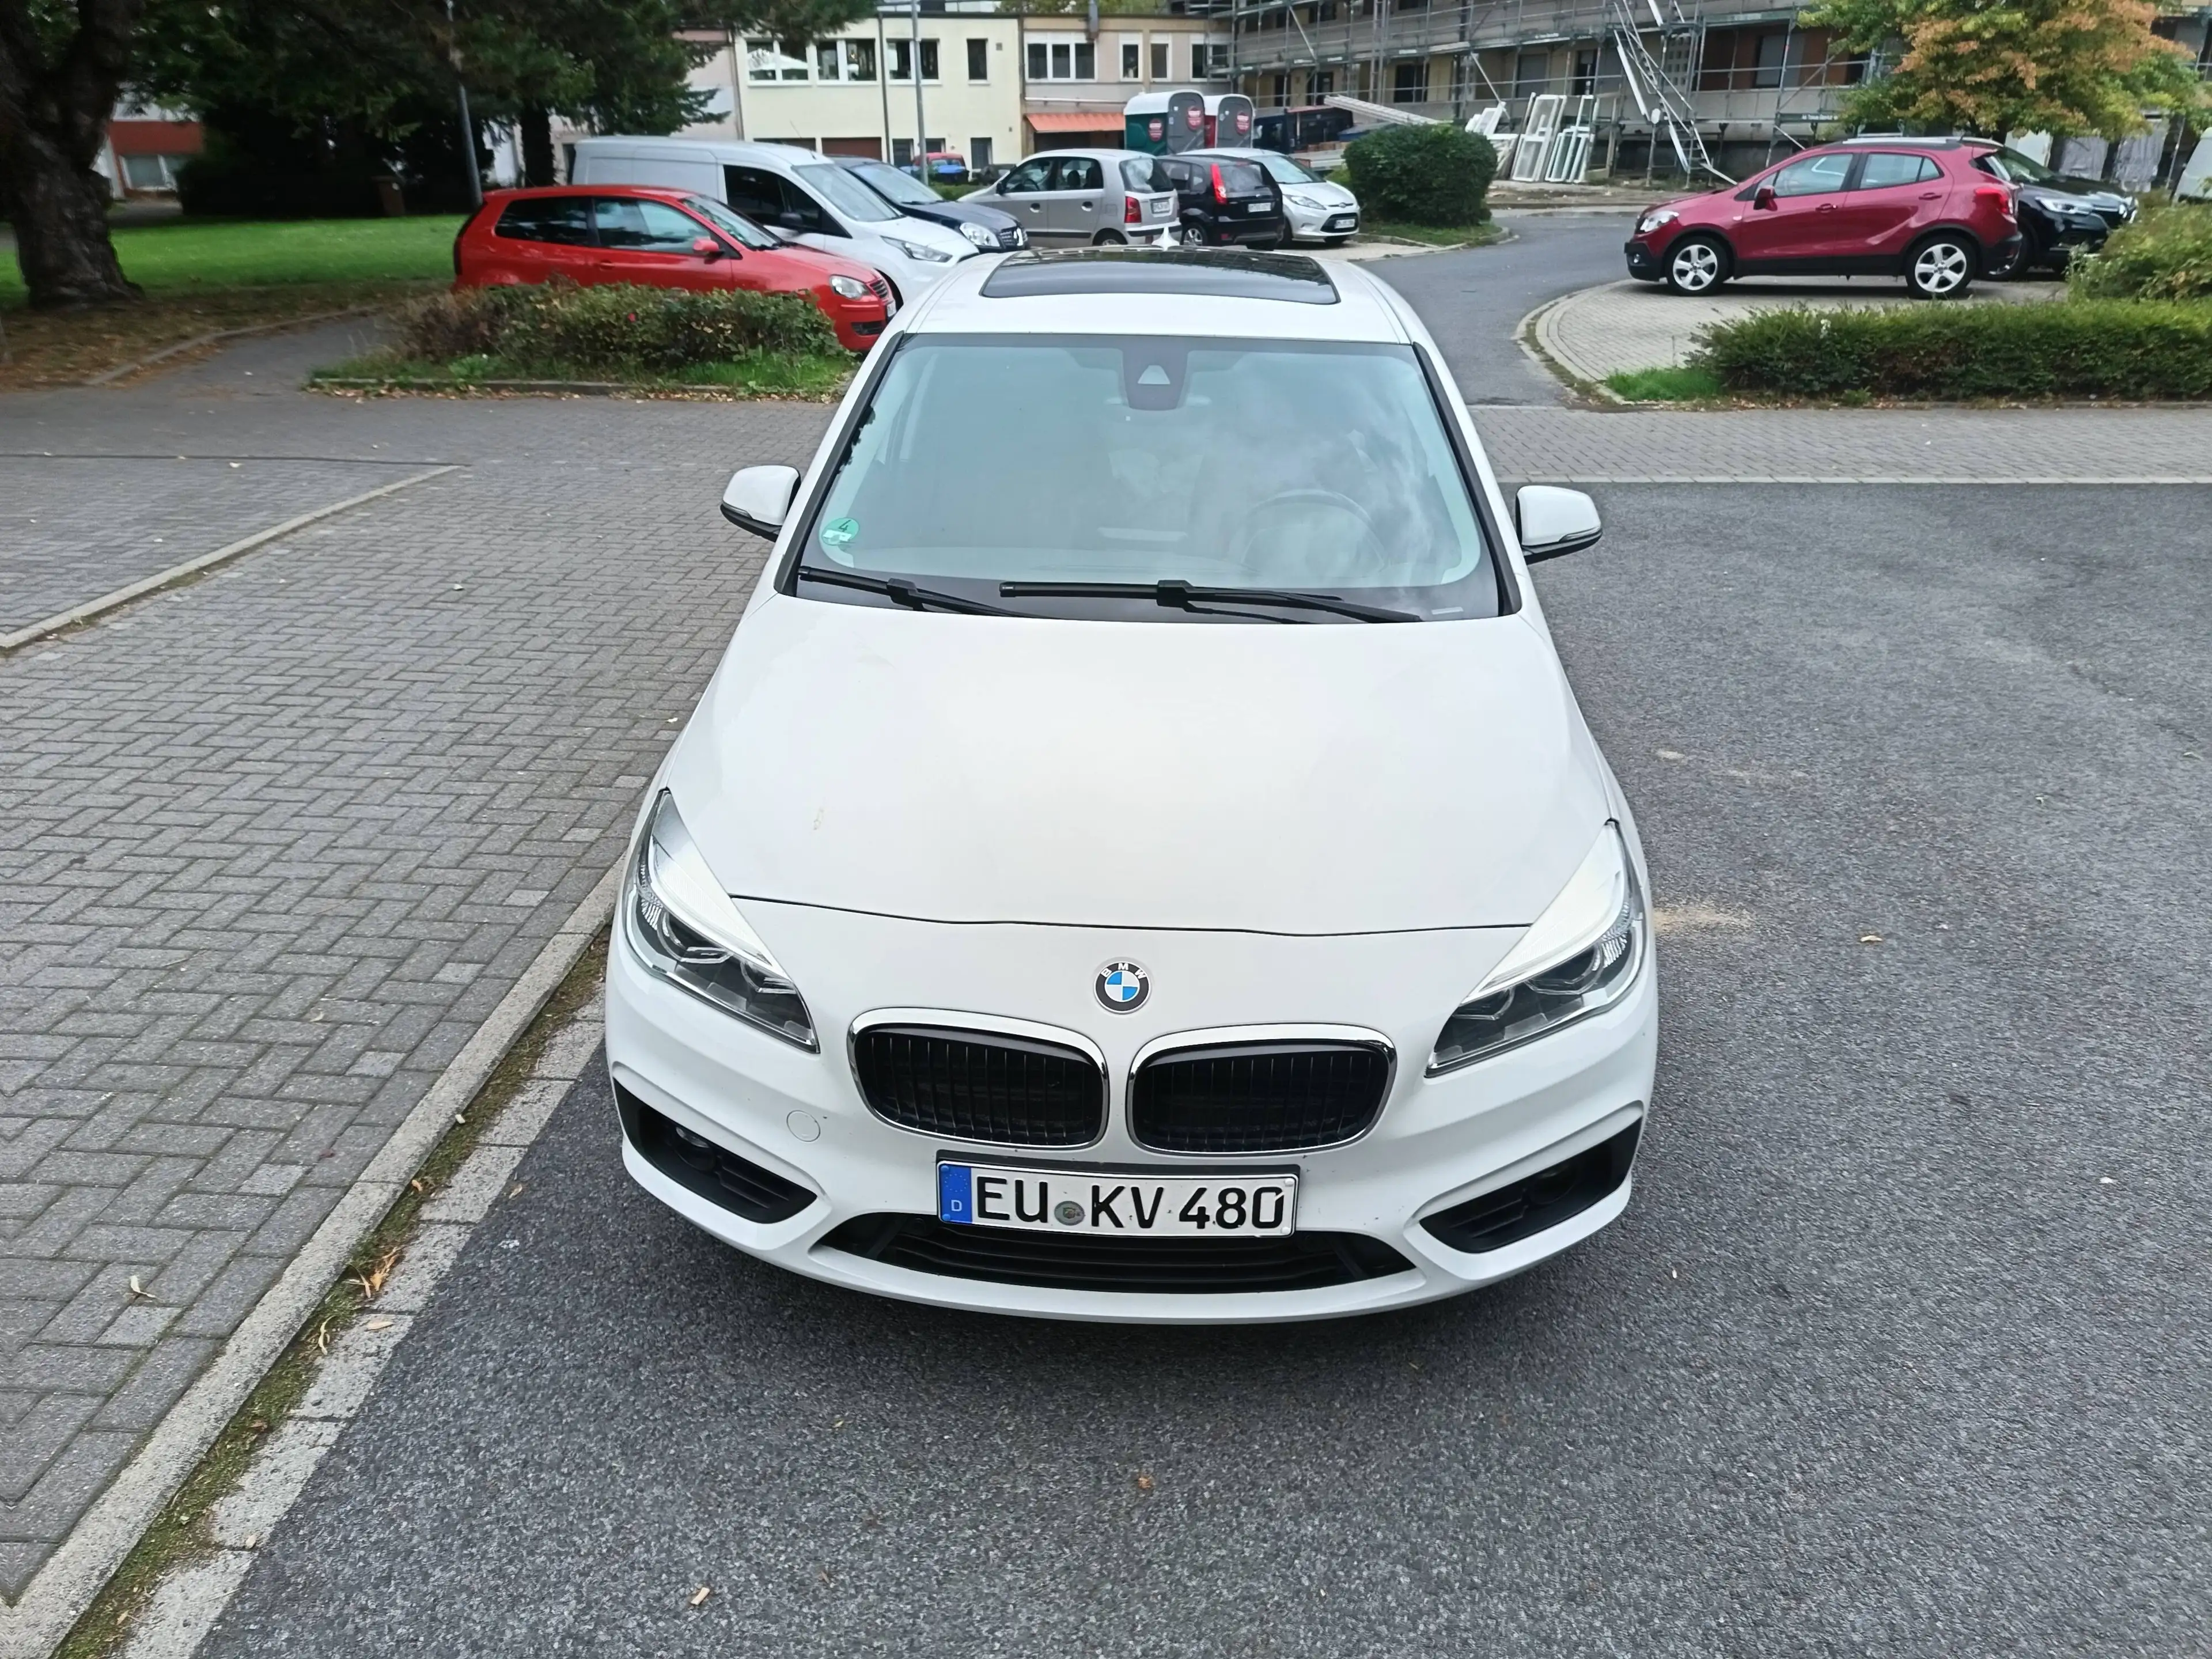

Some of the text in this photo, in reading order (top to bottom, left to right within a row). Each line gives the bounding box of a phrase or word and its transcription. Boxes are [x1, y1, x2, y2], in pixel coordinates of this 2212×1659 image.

[838, 520, 851, 532] 4
[1100, 963, 1147, 979] BMW
[951, 1199, 963, 1211] D
[976, 1176, 1284, 1230] EU KV 480
